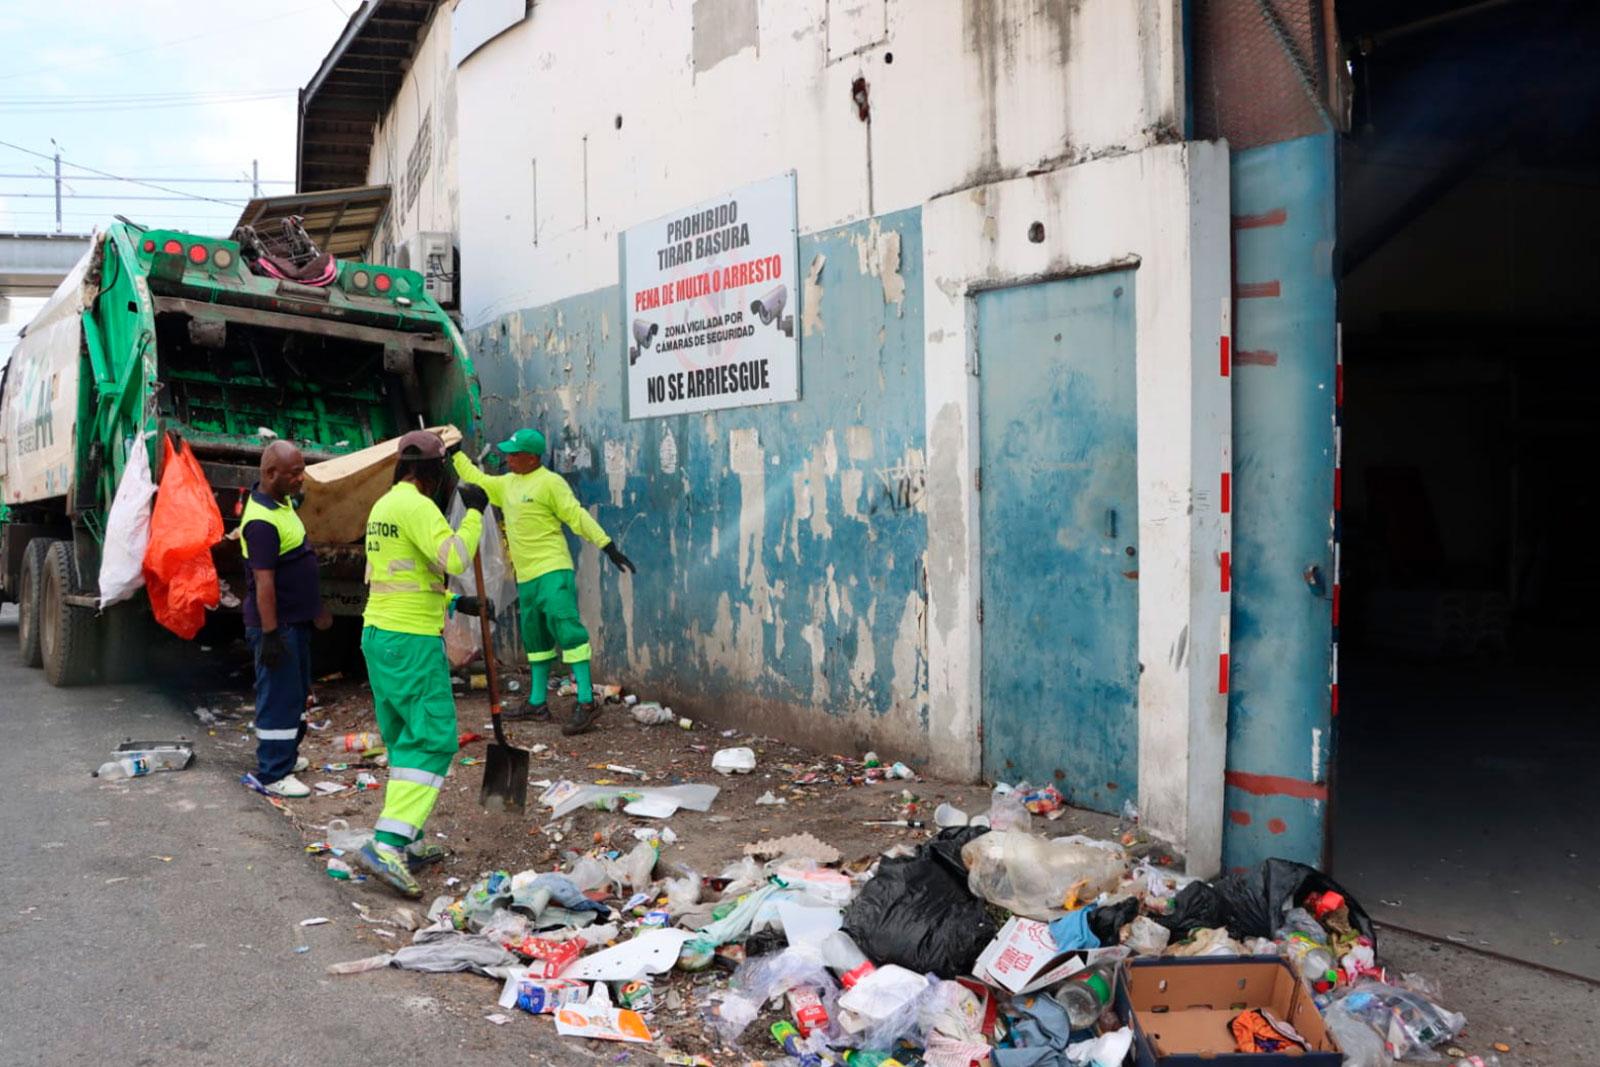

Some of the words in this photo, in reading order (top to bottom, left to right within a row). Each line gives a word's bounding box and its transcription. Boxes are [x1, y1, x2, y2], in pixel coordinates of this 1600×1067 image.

[667, 200, 738, 244] PROHIBIDO
[657, 240, 692, 271] TIRAR
[696, 223, 750, 260] BASURA
[635, 287, 660, 312] PENA
[662, 284, 674, 305] DE
[676, 273, 711, 302] MULTA
[713, 271, 720, 293] O
[723, 254, 782, 290] ARRESTO
[664, 324, 686, 338] ZONA
[687, 315, 723, 334] VIGILADA
[724, 311, 743, 325] POR
[694, 335, 705, 347] DE
[706, 325, 755, 344] SEGURIDAD
[647, 375, 664, 404] NO
[668, 372, 684, 401] SE
[687, 359, 770, 398] ARRIESGUE
